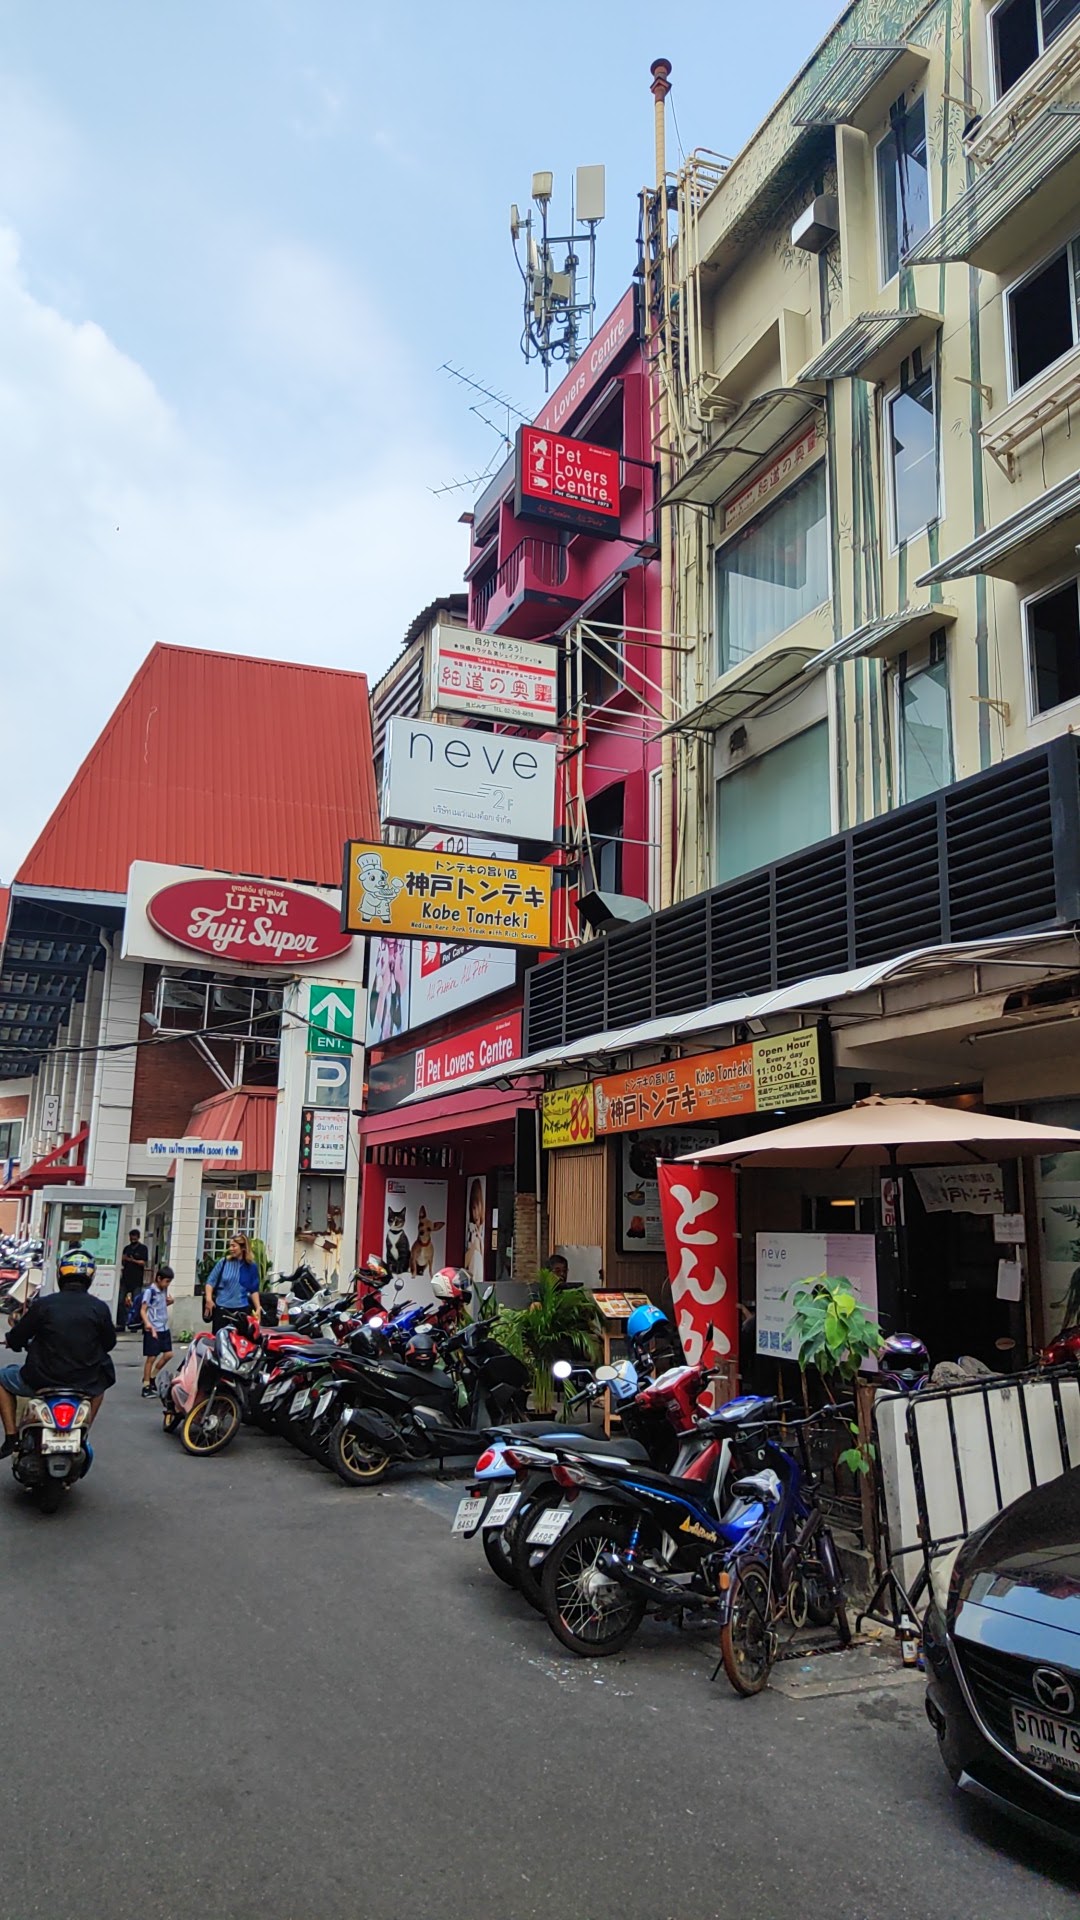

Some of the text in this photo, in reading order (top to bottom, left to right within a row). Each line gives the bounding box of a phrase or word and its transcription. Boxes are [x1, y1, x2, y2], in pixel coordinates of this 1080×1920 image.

[554, 319, 625, 424] Lovers Centre
[555, 443, 581, 465] Pet
[555, 459, 608, 486] Lovers
[555, 474, 608, 501] Centre
[410, 732, 538, 779] neve
[436, 860, 518, 880] トンテキの旨い店
[406, 872, 545, 908] 神戸トンテキ
[225, 892, 289, 916] UFM
[422, 902, 529, 929] Kobe Tonteki
[187, 907, 319, 957] Fuji Super
[411, 922, 432, 930] Medium
[435, 923, 449, 931] Rare
[504, 930, 519, 938] Rich
[317, 1037, 345, 1049] ENT.
[758, 1040, 811, 1058] Open Hour
[427, 1036, 513, 1083] Pet Lovers Centre
[695, 1059, 753, 1086] Kobe Tonteki
[756, 1057, 816, 1076] 11:00-21:30
[766, 1055, 787, 1064] Every
[308, 1059, 348, 1103] P
[625, 1069, 676, 1091] トンテキの旨い店
[610, 1084, 697, 1127] 神戸トンテキ
[761, 1248, 787, 1260] neve
